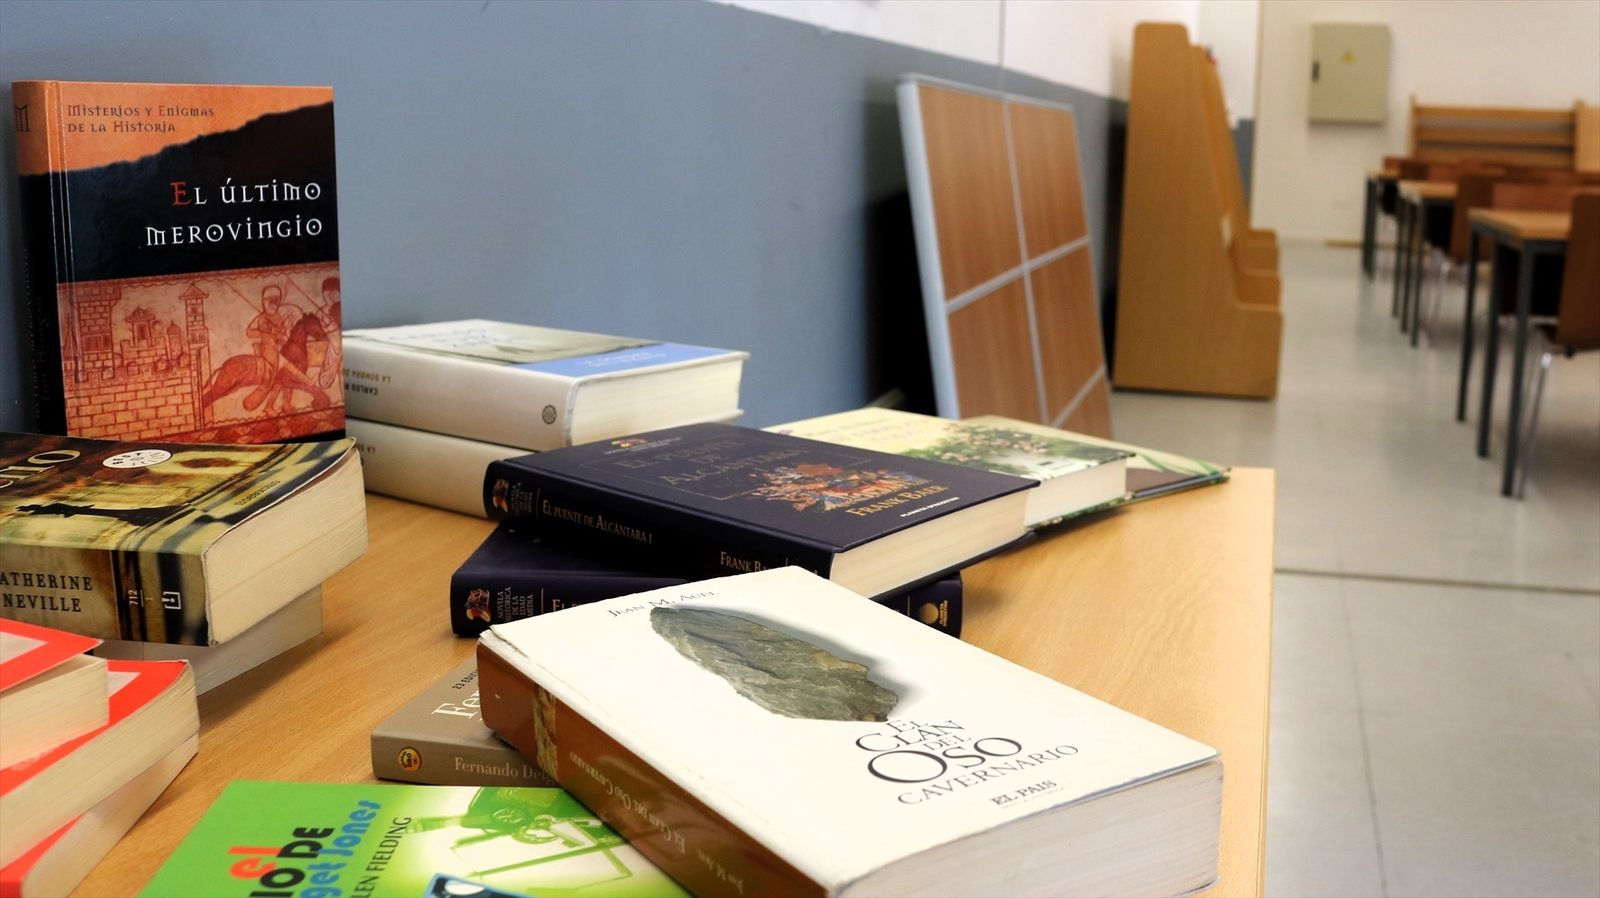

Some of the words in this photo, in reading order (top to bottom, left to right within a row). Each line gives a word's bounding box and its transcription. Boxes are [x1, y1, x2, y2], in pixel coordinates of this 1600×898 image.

[145, 107, 153, 117] Y
[68, 123, 85, 133] DE
[90, 123, 107, 133] LA
[542, 499, 552, 515] EL
[583, 514, 594, 527] DE
[845, 497, 901, 517] FRANK
[720, 551, 752, 573] FRANK
[2, 593, 82, 612] NEVILLE
[127, 589, 138, 606] 712
[607, 603, 646, 618] JEAN
[855, 720, 966, 752] CLAN
[886, 719, 929, 733] EL
[922, 734, 972, 751] DEL
[455, 756, 519, 777] Fernando
[867, 736, 1023, 783] OSO
[897, 745, 1079, 805] CAVERNARIO
[277, 826, 335, 859] DE
[366, 817, 412, 872] FIELDING
